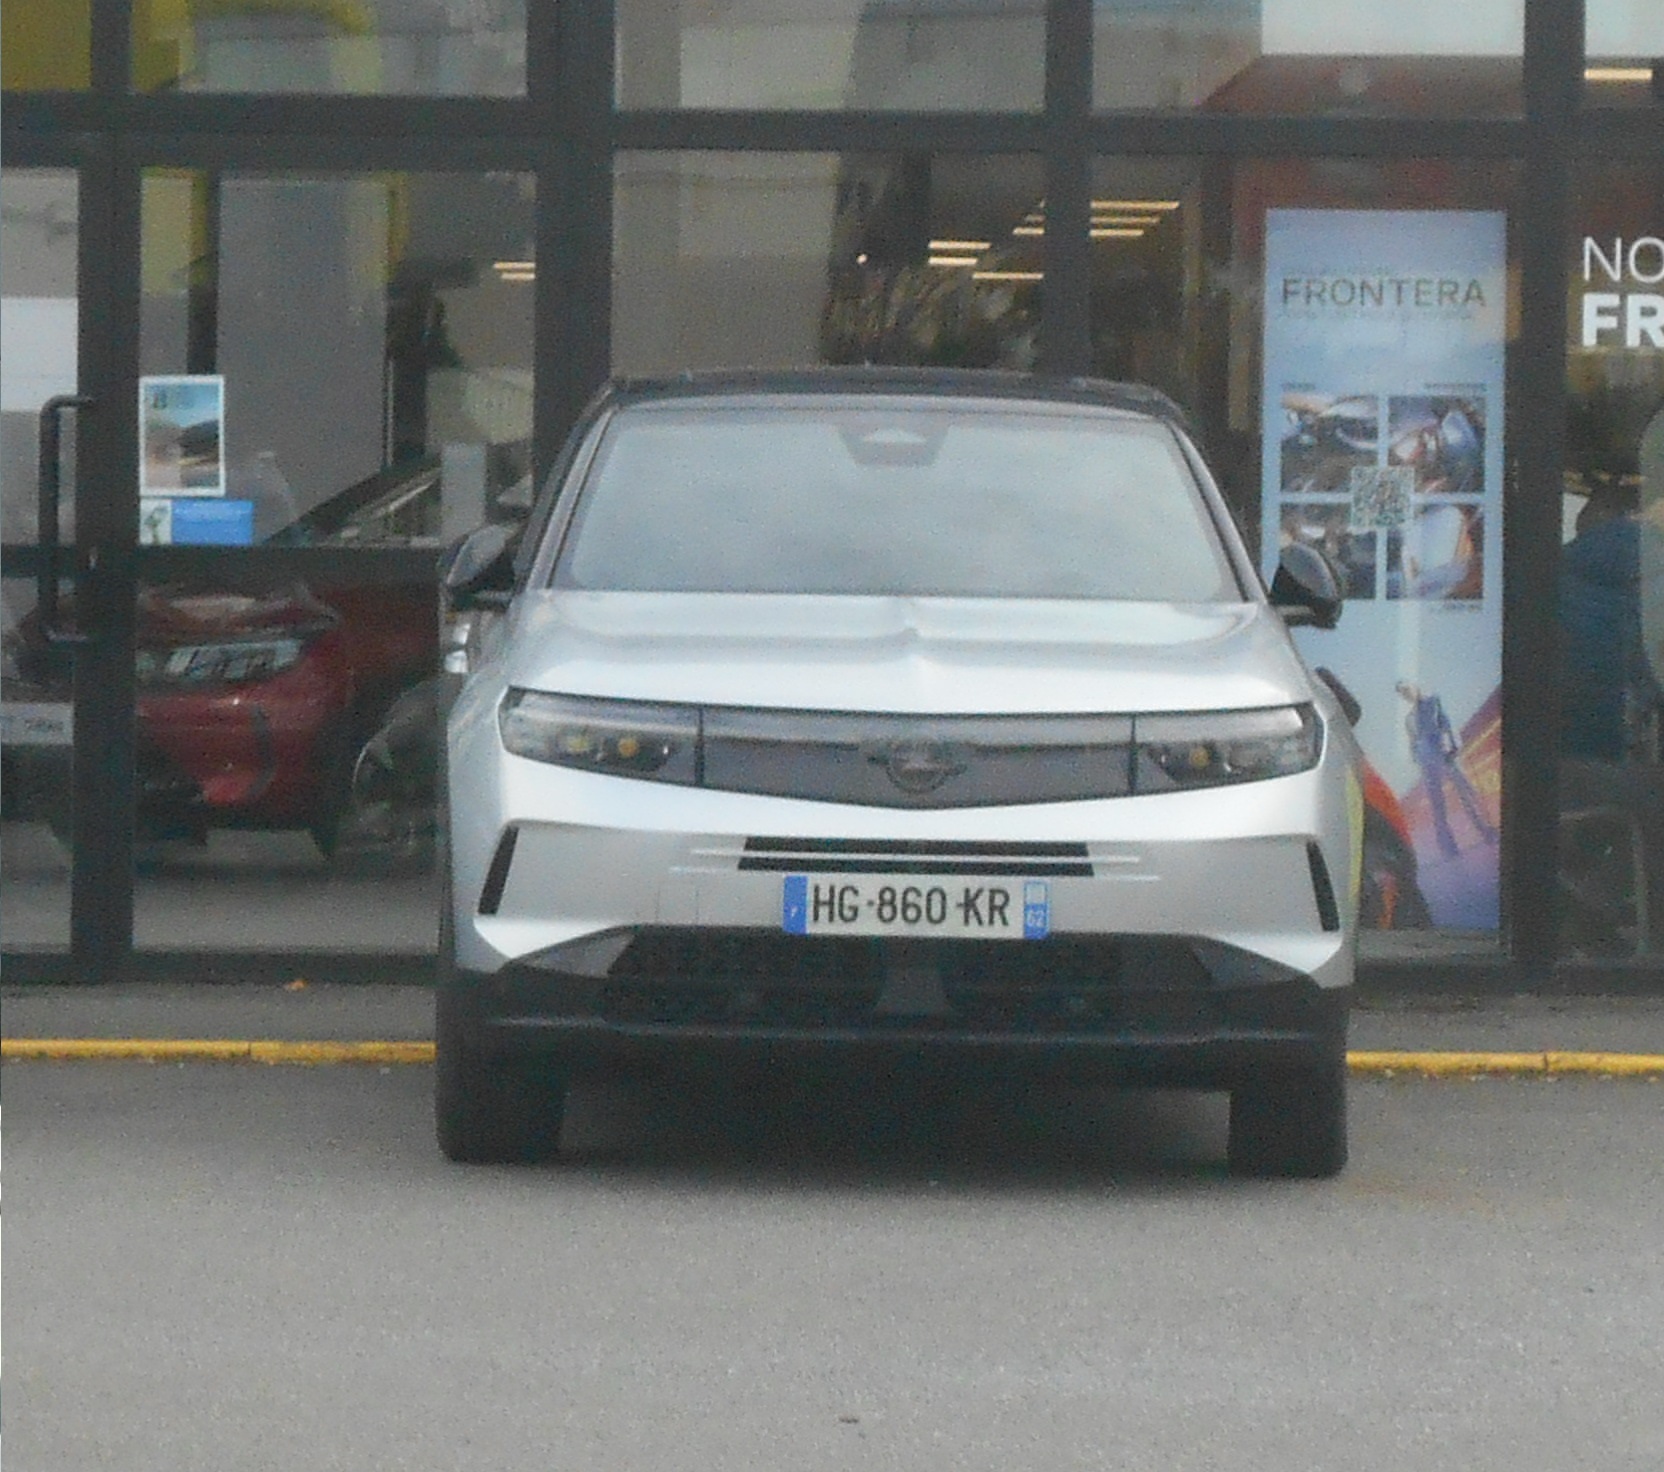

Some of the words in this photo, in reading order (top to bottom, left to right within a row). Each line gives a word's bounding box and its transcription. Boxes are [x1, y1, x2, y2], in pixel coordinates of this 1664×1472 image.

[1583, 236, 1664, 284] NO
[1281, 277, 1487, 308] FRONTERA
[1583, 292, 1664, 348] FR
[812, 883, 1011, 928] HG-860-KR
